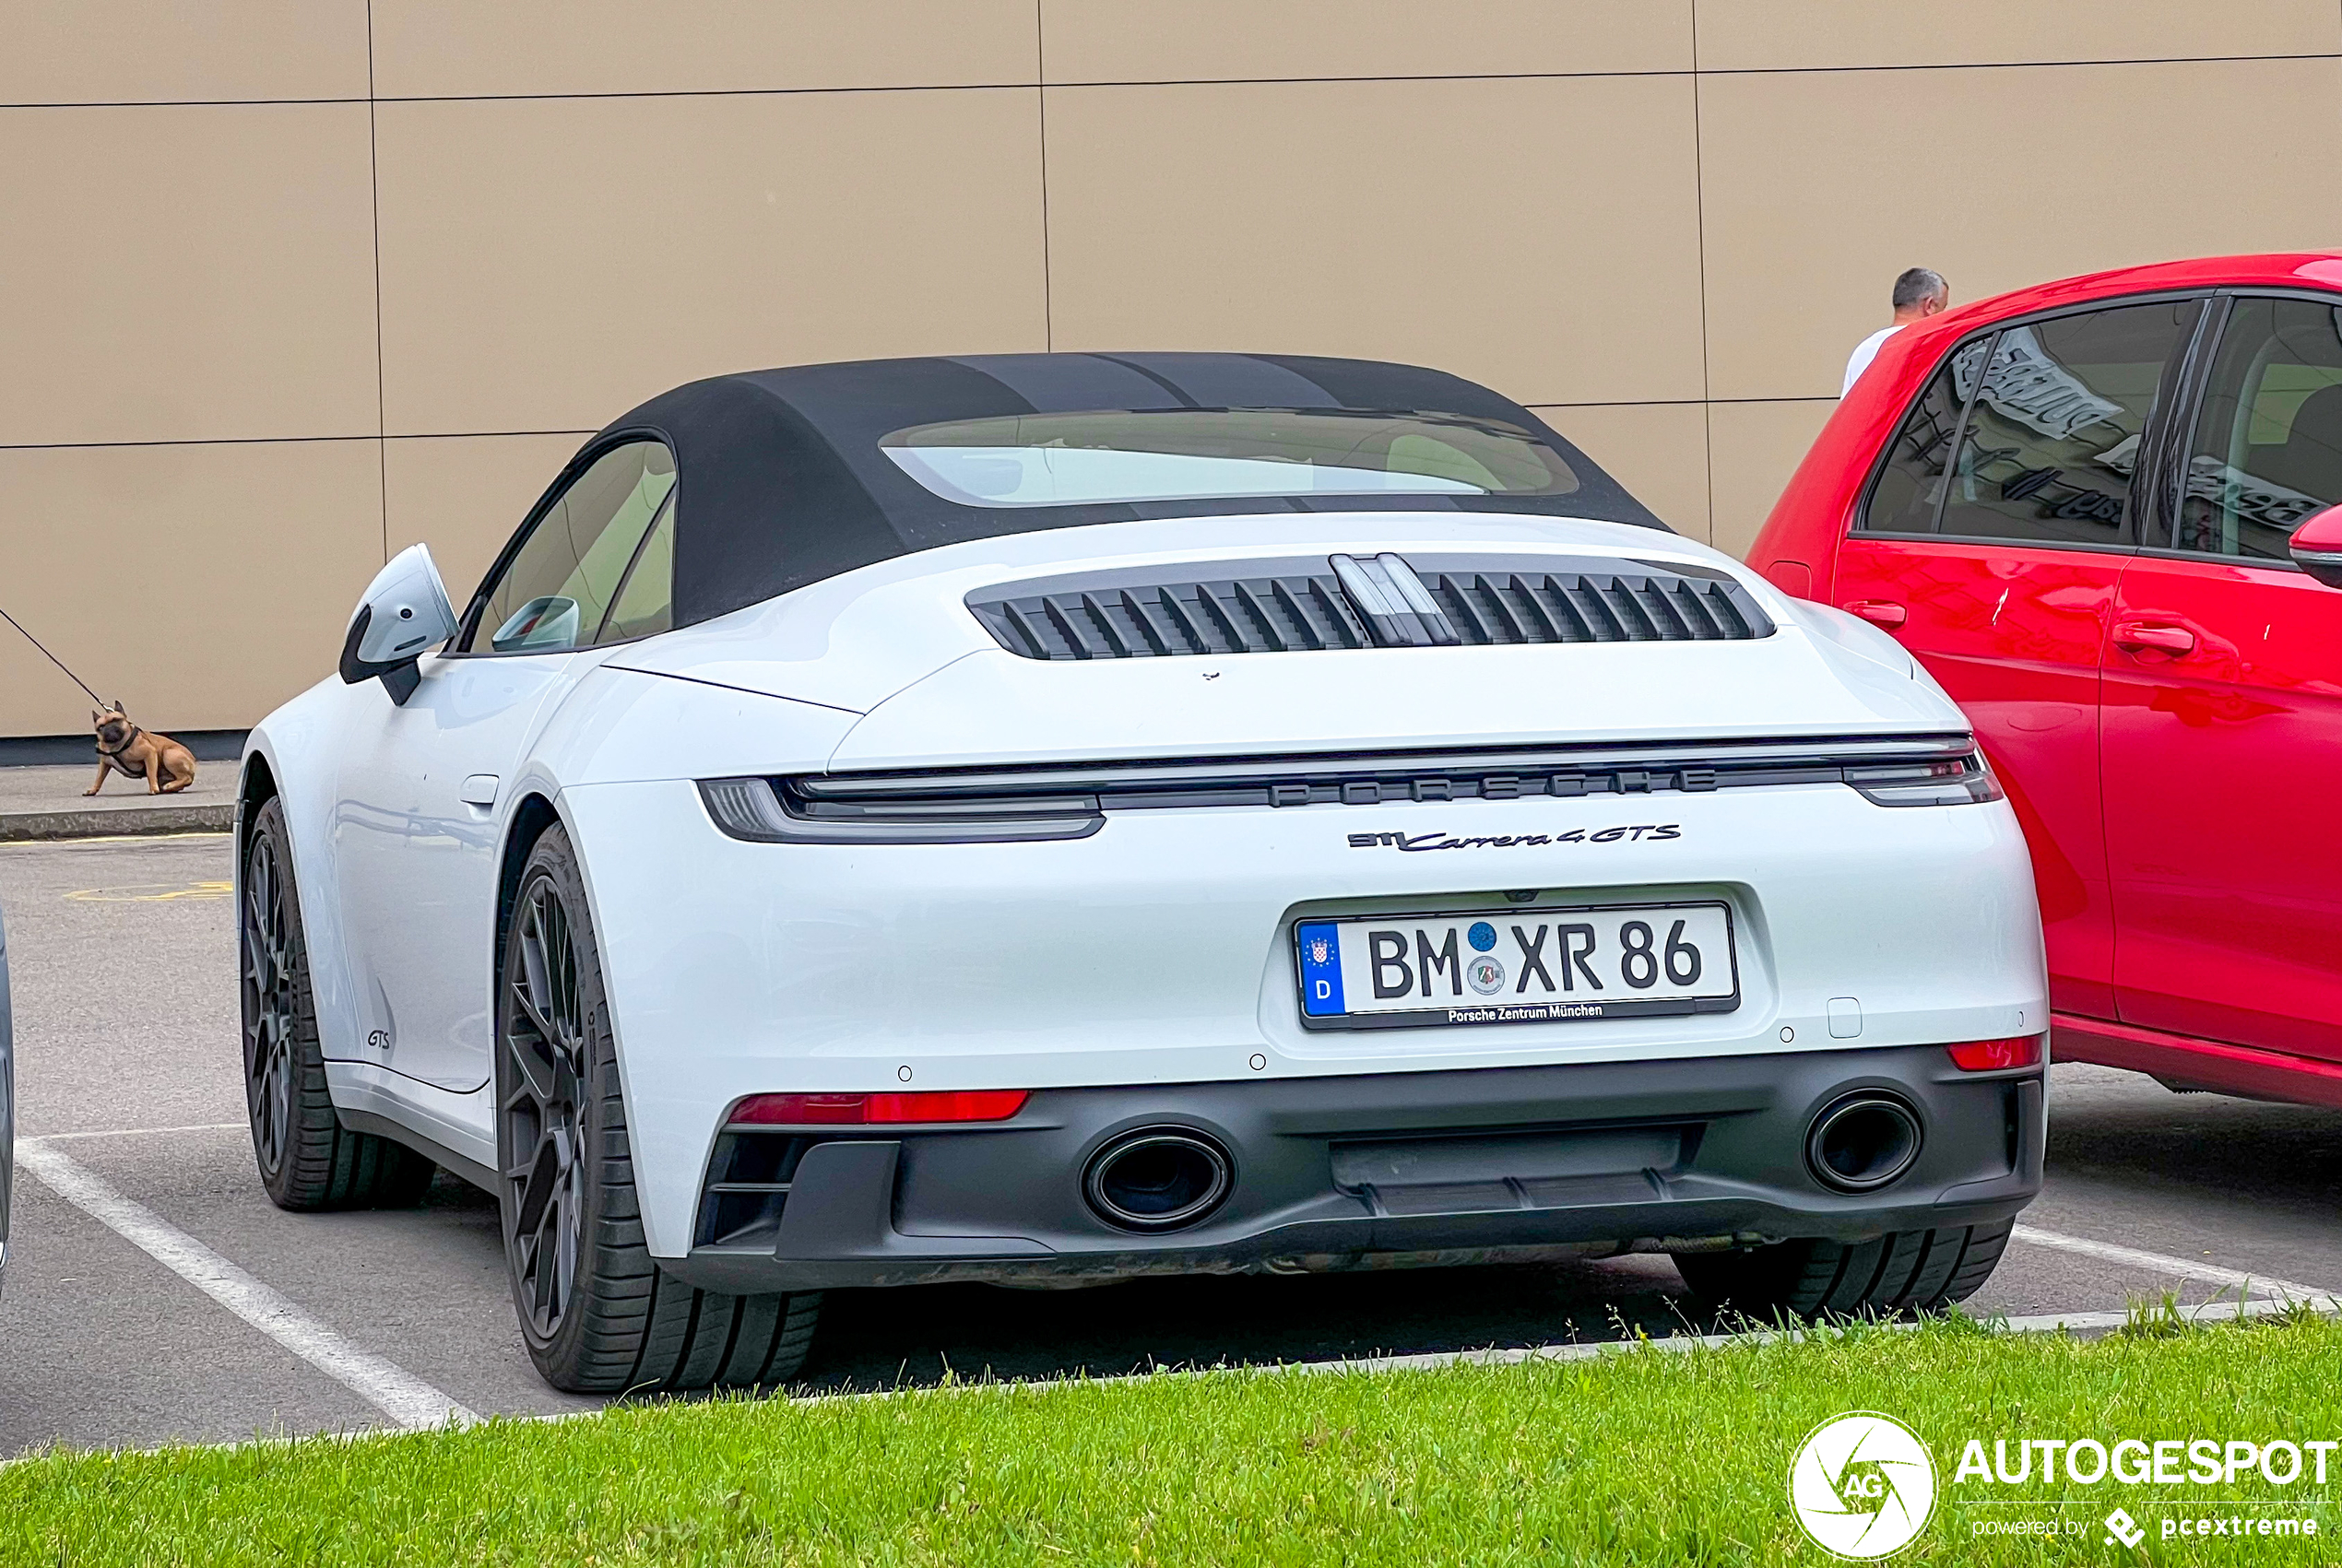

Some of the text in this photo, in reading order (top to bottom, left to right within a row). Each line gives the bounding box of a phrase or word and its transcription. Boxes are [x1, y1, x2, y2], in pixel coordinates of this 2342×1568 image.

[1271, 769, 1719, 808] PORSCHE
[1347, 824, 1682, 852] 911 Carrera 4 GTS
[1368, 928, 1462, 999] BM
[1511, 924, 1603, 993] XR
[1619, 920, 1701, 989] 86
[1315, 980, 1331, 999] D
[1449, 1004, 1603, 1022] Porsche Zentrum München
[368, 1030, 389, 1049] GTS
